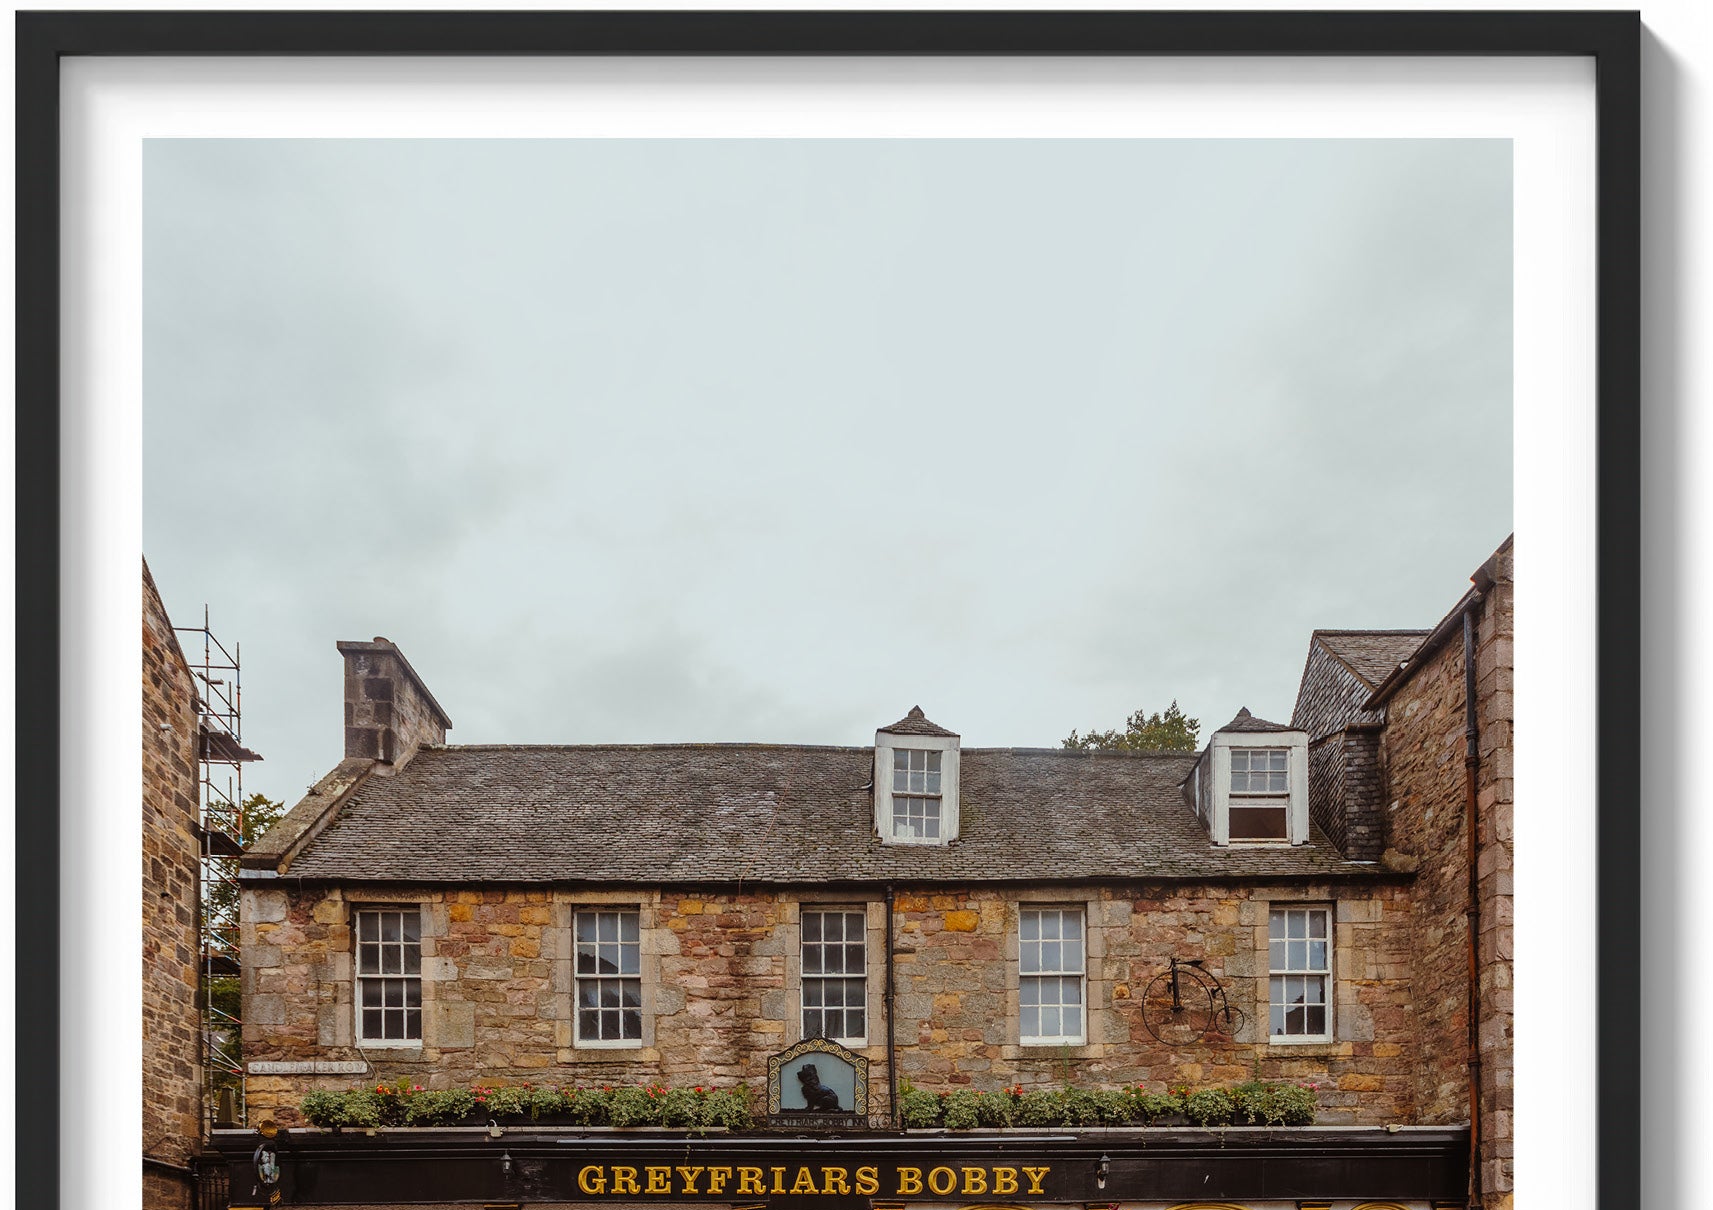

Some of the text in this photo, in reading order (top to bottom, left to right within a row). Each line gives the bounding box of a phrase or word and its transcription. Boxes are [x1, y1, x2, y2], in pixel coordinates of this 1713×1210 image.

[251, 1062, 363, 1073] CANDLEMAKER ROW
[578, 1166, 1051, 1195] GREYFRIARS BOBBY
